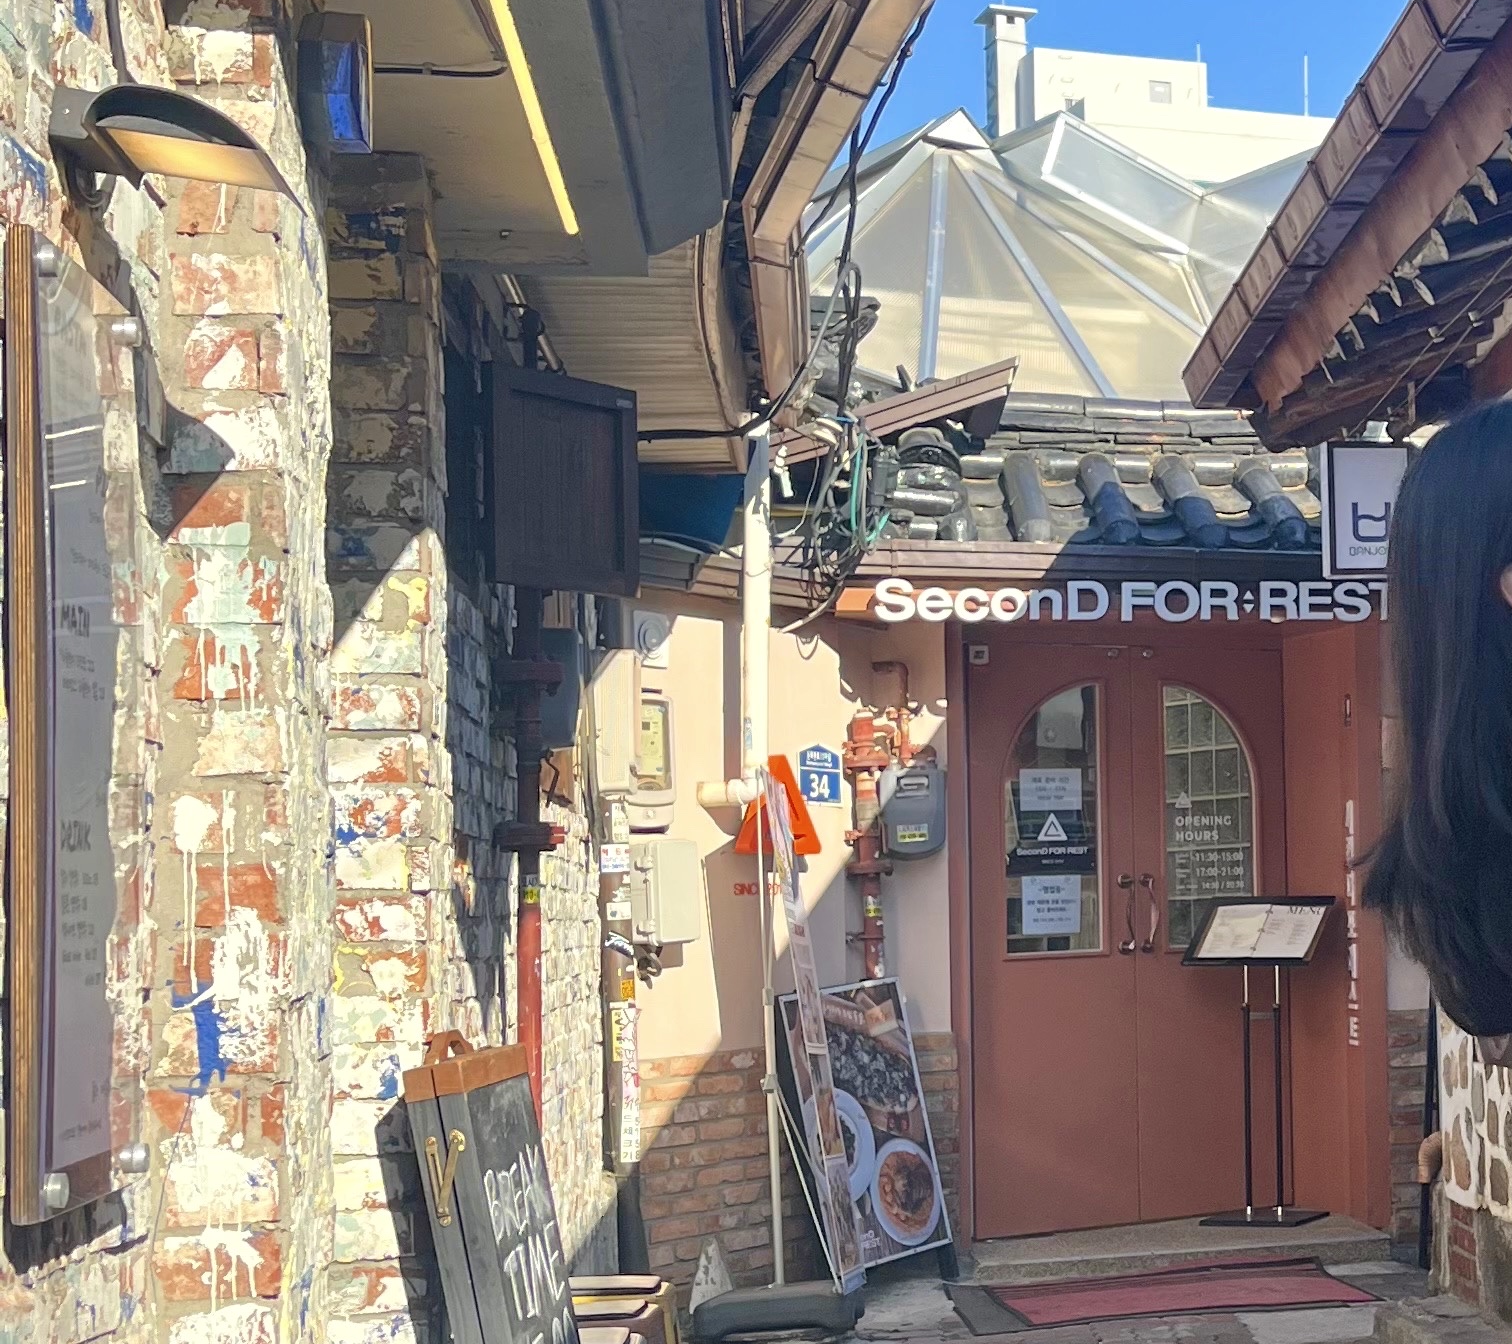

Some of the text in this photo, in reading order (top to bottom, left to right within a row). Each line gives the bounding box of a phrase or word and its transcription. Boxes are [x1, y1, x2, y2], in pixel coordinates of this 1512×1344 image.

[873, 577, 1111, 624] SeconD
[809, 772, 831, 799] 34
[1174, 815, 1232, 827] OPENING
[1175, 829, 1219, 842] HOURS
[483, 1143, 548, 1245] BREAK
[503, 1219, 566, 1324] TIME
